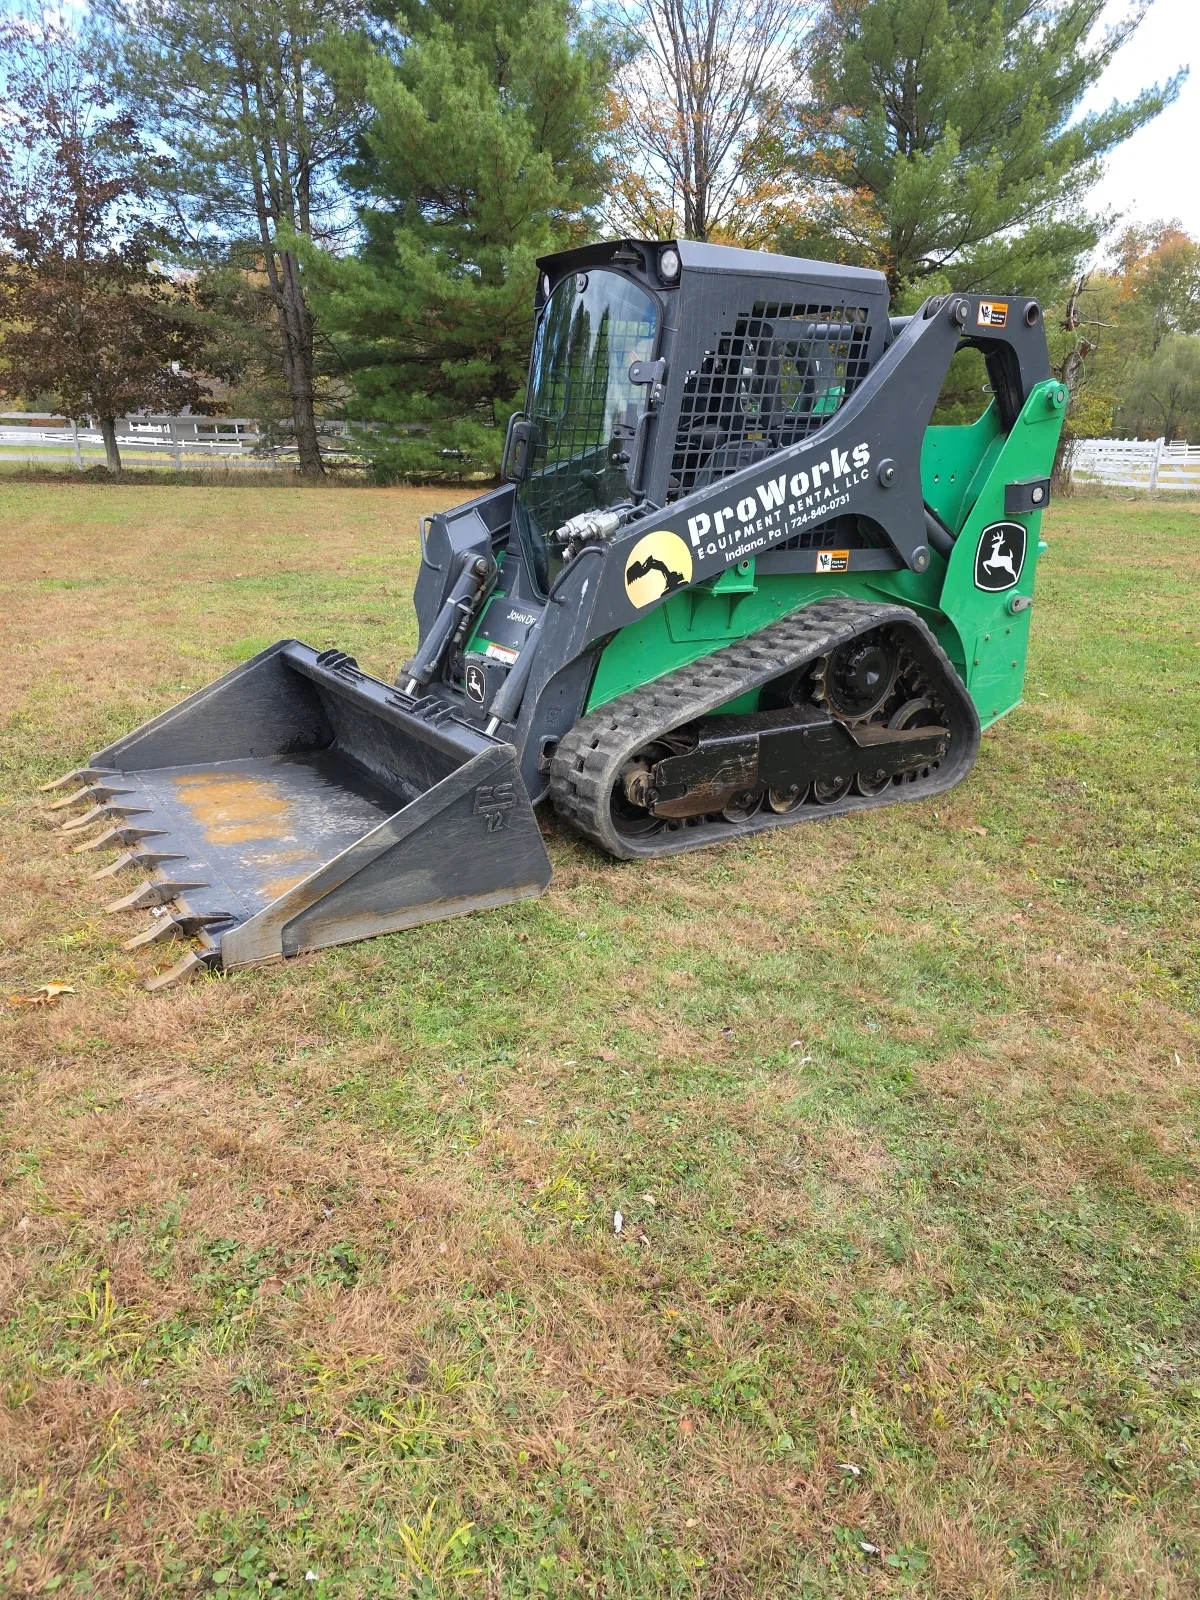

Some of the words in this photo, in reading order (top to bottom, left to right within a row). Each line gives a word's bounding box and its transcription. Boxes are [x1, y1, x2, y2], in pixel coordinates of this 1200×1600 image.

[687, 442, 870, 547] ProWorks
[697, 510, 782, 560] EQUIPMENT
[788, 486, 840, 515] RENTAL
[845, 468, 869, 488] LLC
[725, 538, 767, 562] Indiana,
[768, 528, 782, 541] Pa
[790, 492, 850, 529] 724-840-0731
[507, 609, 526, 623] JOHN
